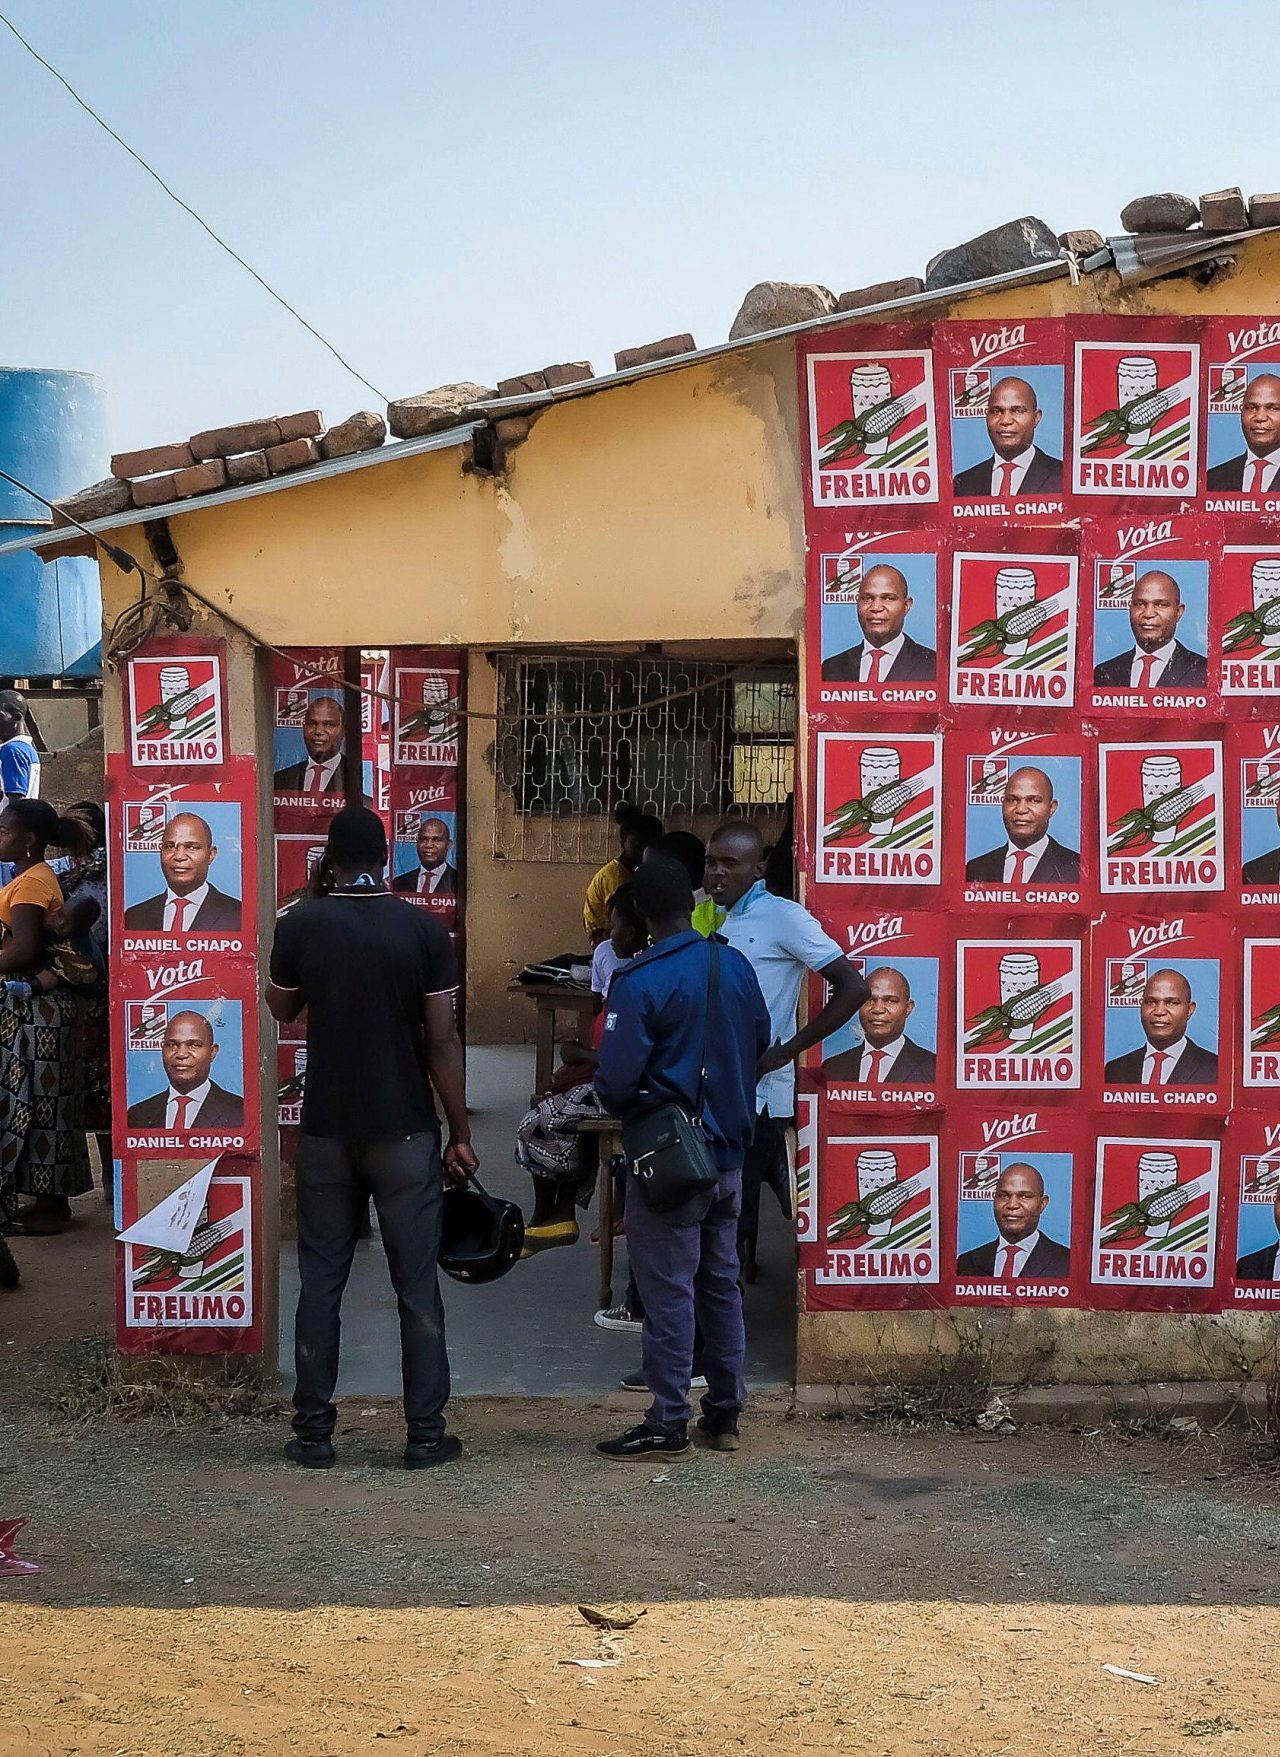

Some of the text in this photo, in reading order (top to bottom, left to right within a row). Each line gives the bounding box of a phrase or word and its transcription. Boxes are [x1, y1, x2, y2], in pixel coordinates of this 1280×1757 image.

[969, 325, 1025, 357] Vota
[820, 472, 930, 499] FRELIMO
[1080, 463, 1189, 488] FRELIMO
[954, 504, 1010, 516] DANIEL
[1206, 500, 1260, 512] DANIEL
[1117, 521, 1172, 551] Vota
[821, 690, 936, 701] DANIEL CHAPO
[957, 672, 1066, 699] FRELIMO
[1092, 696, 1206, 708] DANIEL CHAPO
[138, 742, 217, 760] FRELIMO
[399, 744, 456, 761] FRELIM
[274, 797, 318, 806] DANIEL
[408, 786, 445, 804] Vota
[824, 852, 933, 877] FRELIMO
[1108, 860, 1216, 885] FRELIMO
[964, 891, 1079, 903] DANIEL CHAPO
[846, 917, 902, 946] Vota
[1128, 919, 1183, 949] Vota
[124, 939, 242, 951] DANIEL CHAPO
[146, 959, 203, 990] Vota
[964, 1058, 1073, 1081] FRELIMO
[882, 1091, 934, 1102] CHAPO
[1104, 1092, 1216, 1104] DANIEL CHAPO
[982, 1113, 1037, 1143] Vota
[127, 1137, 244, 1148] DANIEL CHAPO
[825, 1253, 932, 1277] FRELIMO
[1099, 1254, 1207, 1280] FRELIMO
[956, 1285, 1068, 1297] DANIEL CHAPO
[134, 1296, 245, 1323] FRELIMO
